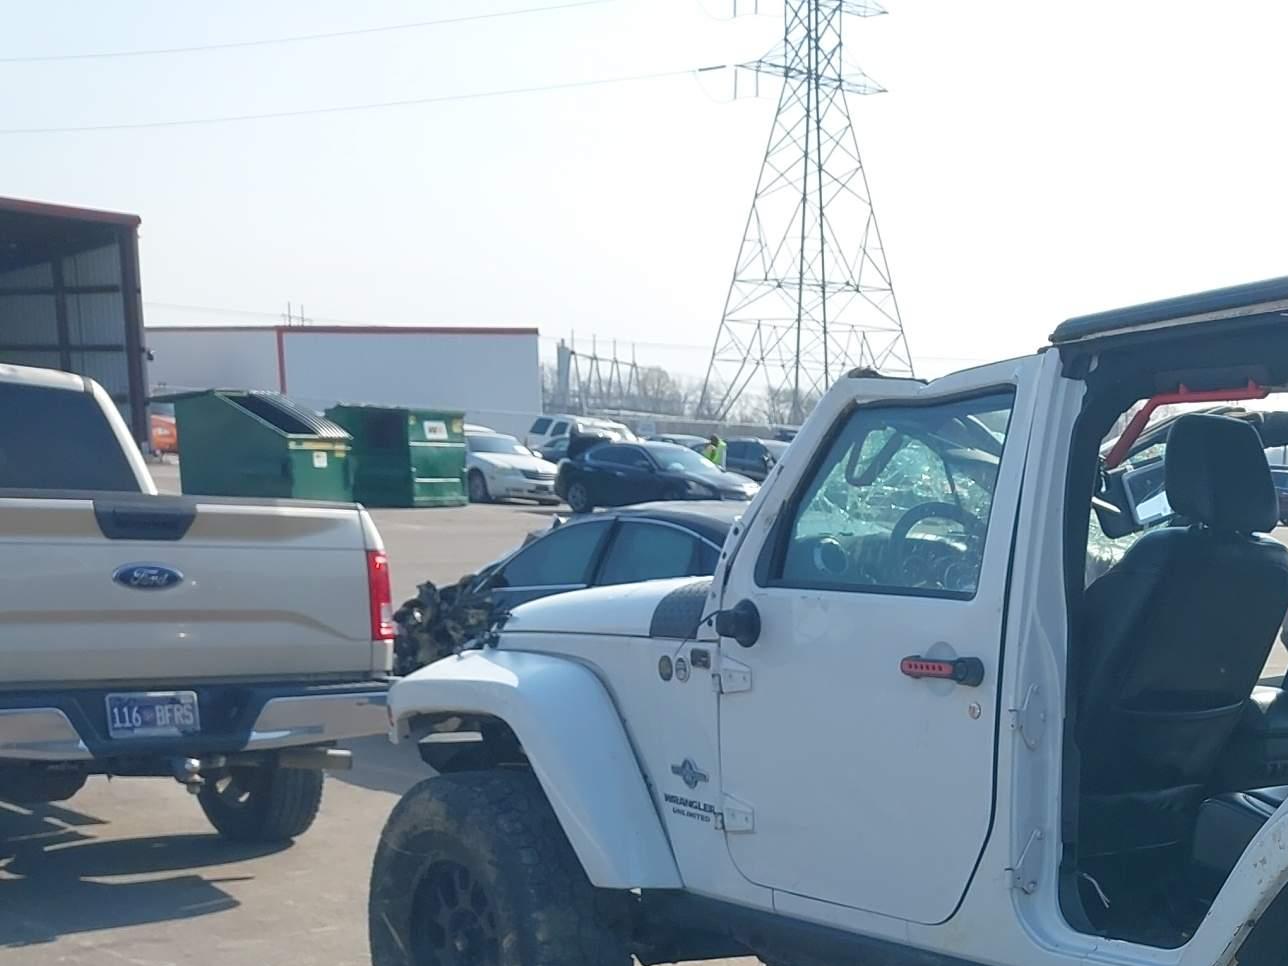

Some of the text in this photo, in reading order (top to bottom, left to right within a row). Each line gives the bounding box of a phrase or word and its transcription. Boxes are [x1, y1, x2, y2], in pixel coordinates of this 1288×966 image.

[130, 567, 169, 585] Ford
[113, 706, 142, 728] 116
[664, 793, 716, 814] WRANGLER
[672, 807, 711, 823] UNLIMITED
